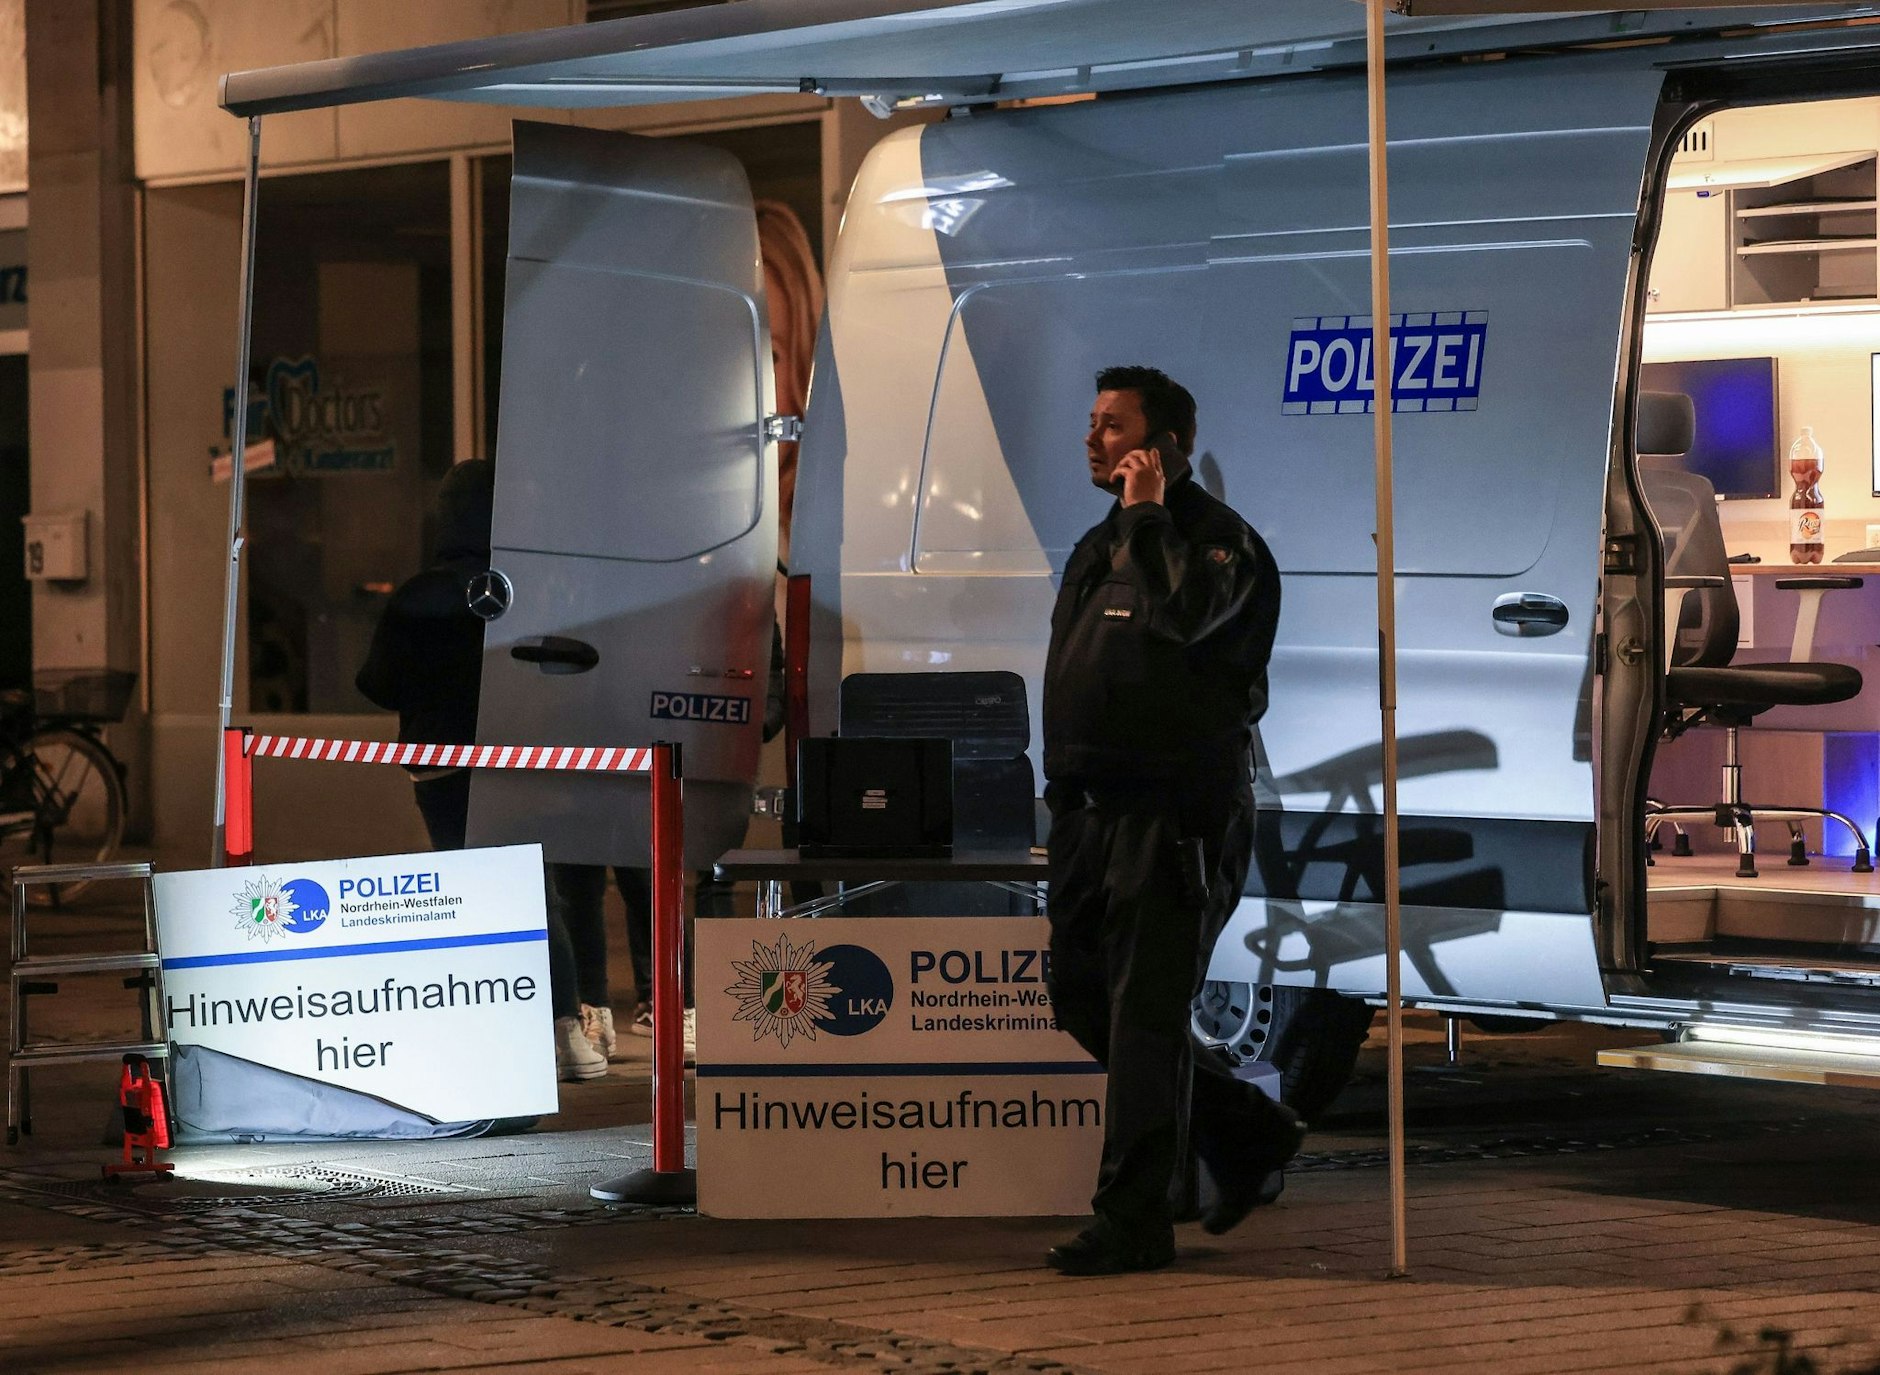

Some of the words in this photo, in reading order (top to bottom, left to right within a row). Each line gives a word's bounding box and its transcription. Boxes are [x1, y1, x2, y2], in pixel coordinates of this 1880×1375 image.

[1289, 333, 1480, 393] POLIZEI
[652, 693, 749, 721] POLIZEI
[339, 872, 440, 899] POLIZEI
[303, 909, 328, 922] LKA
[340, 895, 463, 914] Nordrhein-Westfalen
[341, 909, 456, 928] Landeskriminalamt
[910, 949, 1052, 984] POLIZE
[168, 974, 537, 1029] Hinweisaufnahme
[848, 998, 888, 1015] LKA
[912, 1013, 1057, 1031] Landeskrimina
[316, 1037, 393, 1072] hier
[715, 1090, 1101, 1130] Hinweisaufnahm
[882, 1151, 968, 1189] hier
